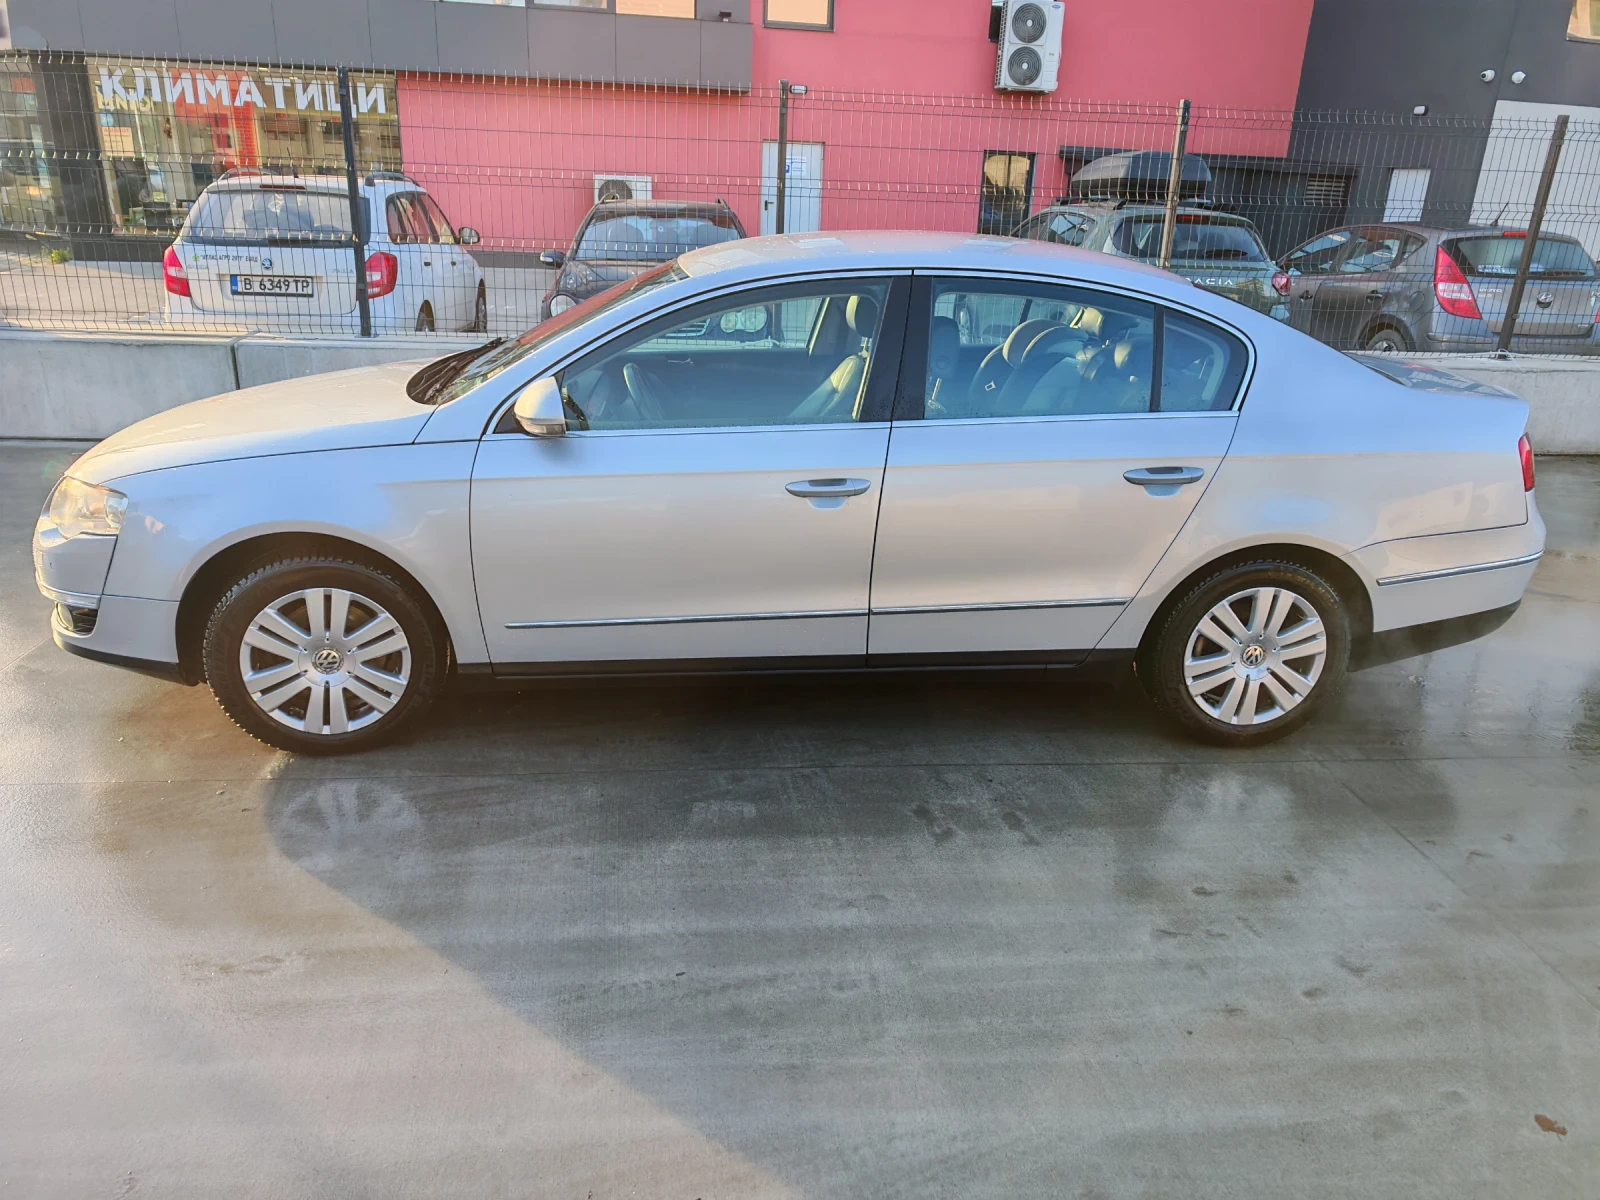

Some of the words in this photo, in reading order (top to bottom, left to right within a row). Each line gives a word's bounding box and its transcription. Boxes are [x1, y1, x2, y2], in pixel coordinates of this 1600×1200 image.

[99, 67, 386, 118] КЛИМАТИЦИ
[243, 277, 252, 291] B
[259, 278, 290, 292] 6349
[293, 279, 310, 292] TP
